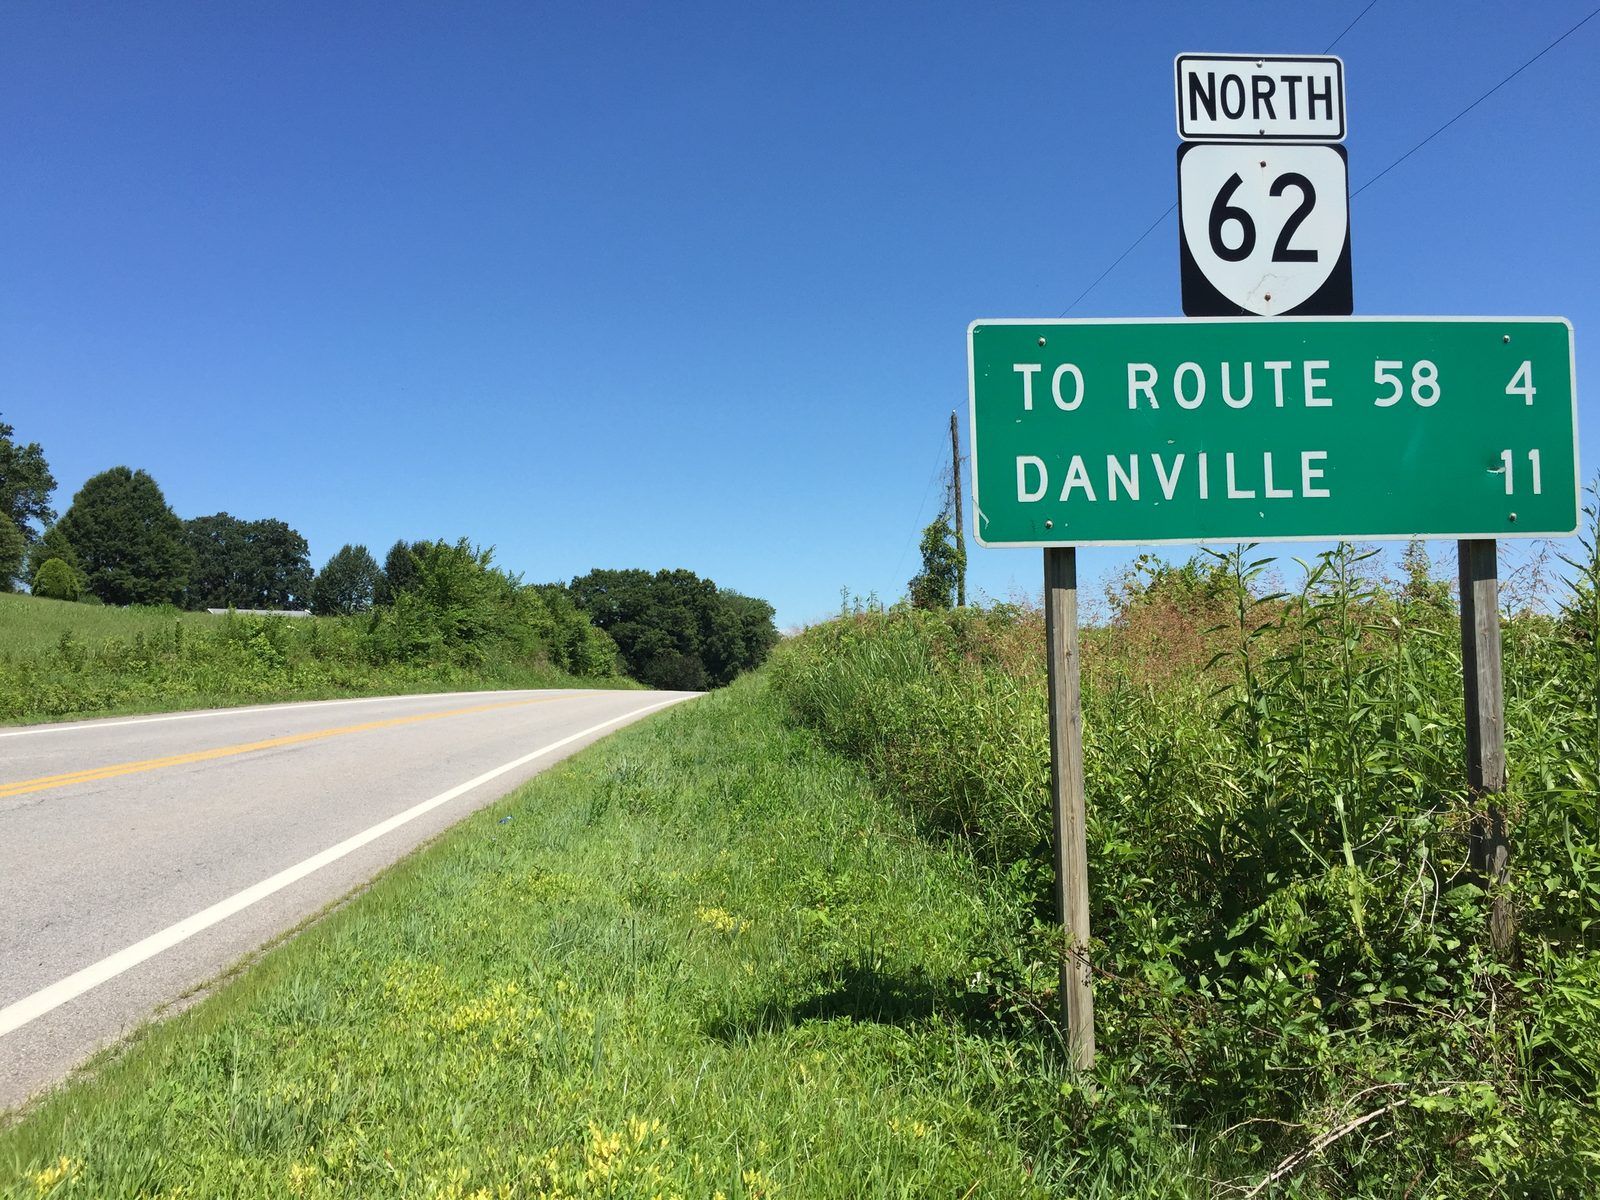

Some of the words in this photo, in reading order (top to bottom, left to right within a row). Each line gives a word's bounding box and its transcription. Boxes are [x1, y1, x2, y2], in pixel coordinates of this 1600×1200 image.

[1188, 71, 1333, 121] NORTH
[1208, 172, 1319, 263] 62
[1013, 363, 1085, 411] TO
[1127, 360, 1333, 410] ROUTE
[1374, 359, 1441, 407] 58
[1505, 360, 1537, 406] 4
[1016, 451, 1331, 503] DANVILLE
[1500, 449, 1542, 495] 11
